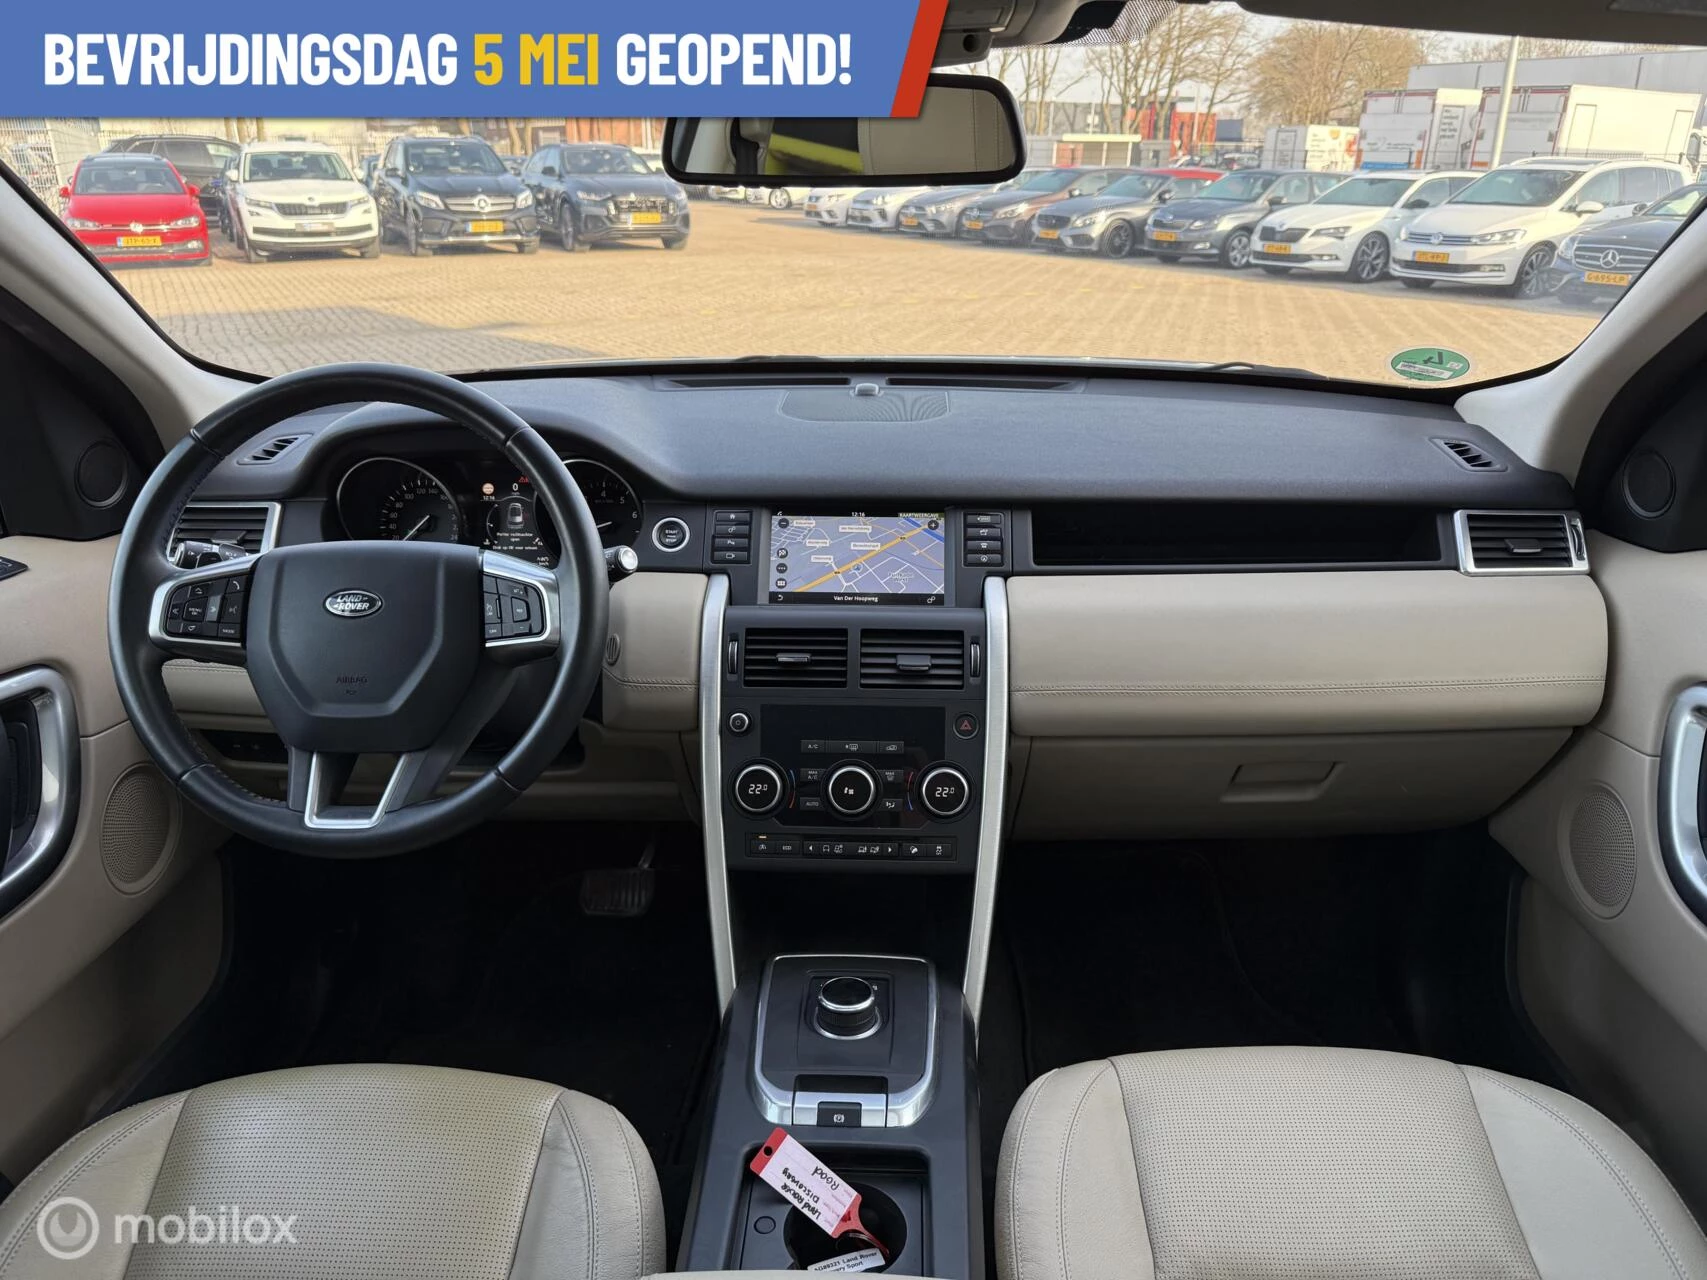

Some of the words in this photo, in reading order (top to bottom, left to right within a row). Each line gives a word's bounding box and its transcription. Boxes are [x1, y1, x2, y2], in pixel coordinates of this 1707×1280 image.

[632, 511, 638, 519] 6
[336, 594, 363, 603] LAND
[338, 602, 370, 610] ROVER
[842, 1255, 858, 1264] Land
[859, 1251, 877, 1260] Rover
[846, 1260, 864, 1270] Sport
